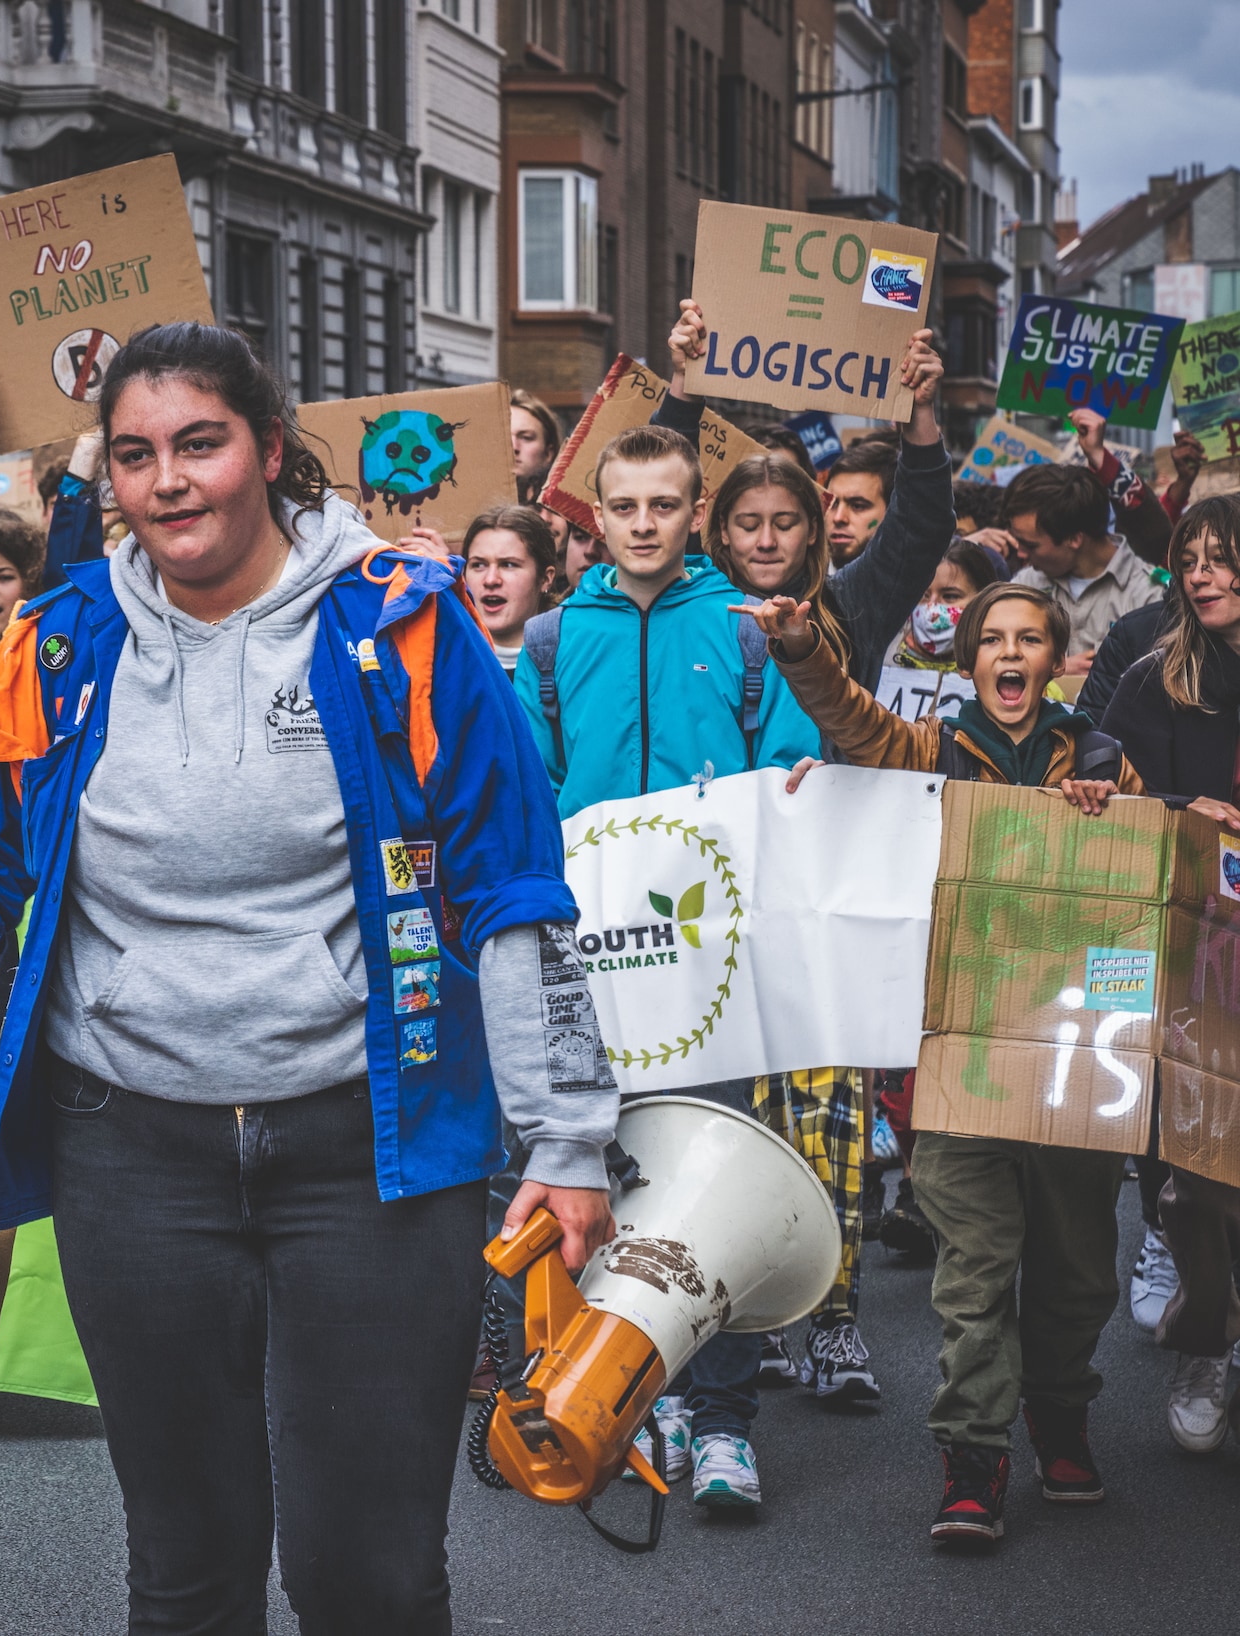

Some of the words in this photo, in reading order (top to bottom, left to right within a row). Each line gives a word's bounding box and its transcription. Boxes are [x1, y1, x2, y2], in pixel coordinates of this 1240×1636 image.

[33, 239, 94, 276] NO
[760, 222, 867, 285] ECO
[872, 266, 907, 286] CHANGE
[9, 255, 152, 326] PLANET
[1025, 305, 1163, 353] CLIMATE
[1180, 325, 1240, 365] THERE
[704, 331, 892, 399] LOGISCH
[1020, 337, 1155, 378] JUSTICE
[1183, 375, 1240, 404] PLANE
[704, 444, 726, 461] old
[50, 644, 68, 667] LUCKY
[277, 726, 326, 735] CONVERSA
[407, 925, 433, 936] TALENT
[416, 935, 431, 943] TEN
[579, 923, 675, 955] OUTH
[585, 961, 595, 974] R
[598, 951, 679, 972] CLIMATE
[1091, 969, 1101, 978] IK
[1101, 968, 1131, 978] SPIJBEL
[1132, 967, 1149, 976] NIET
[1092, 958, 1102, 968] IK
[1102, 957, 1132, 967] SPIJBEL
[1132, 956, 1150, 965] NIET
[1090, 981, 1104, 994] IK
[1105, 979, 1146, 993] STAAK
[547, 991, 584, 1005] GOOD
[548, 1003, 576, 1015] TIME
[548, 1031, 567, 1048] TOY
